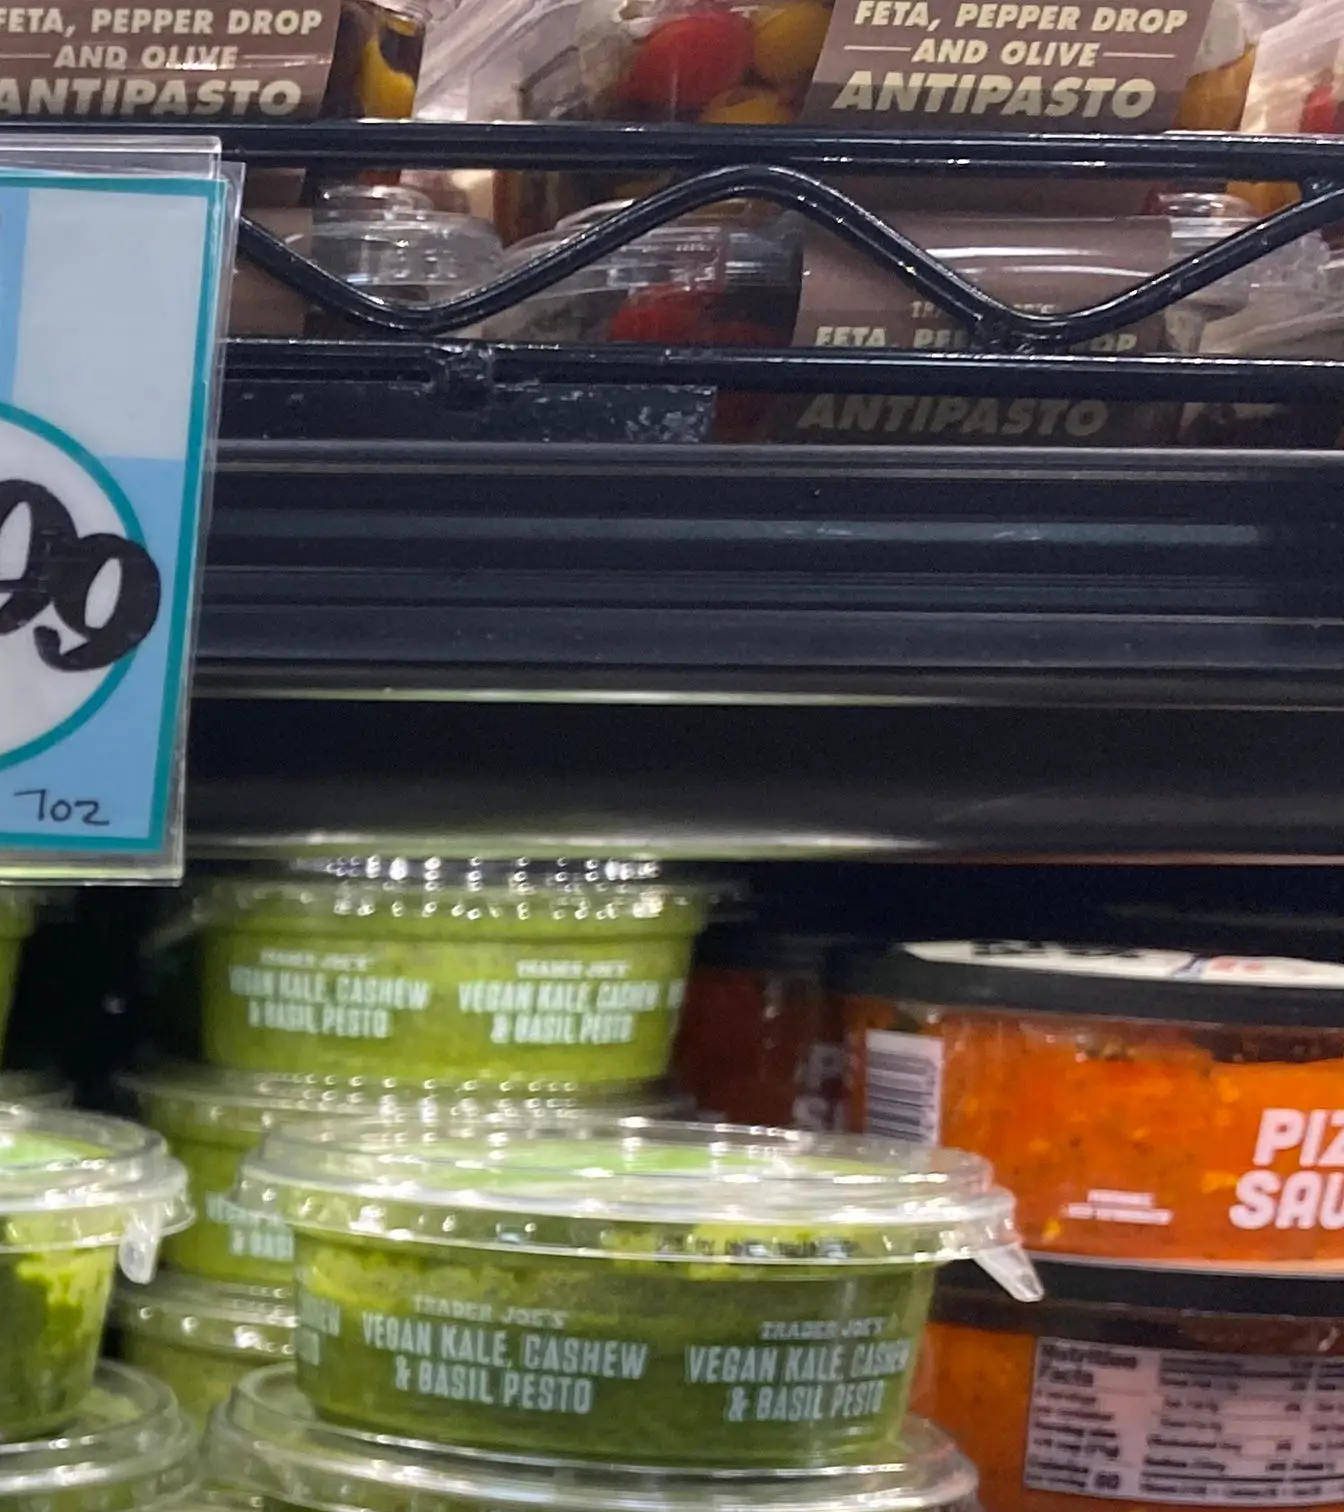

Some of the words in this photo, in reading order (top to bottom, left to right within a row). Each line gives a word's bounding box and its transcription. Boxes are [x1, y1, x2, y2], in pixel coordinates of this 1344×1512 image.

[91, 8, 214, 35] PEPPER
[227, 10, 322, 35] DROP
[854, 0, 941, 32] FETA,
[955, 3, 1080, 31] PEPPER
[1091, 8, 1188, 34] DROP
[53, 45, 128, 69] AND
[141, 45, 238, 71] OLIVE
[912, 38, 989, 64] AND
[1001, 41, 1100, 67] OLIVE
[831, 71, 1156, 119] ANTIPASTO
[796, 394, 1109, 437] ANTIPASTO
[362, 1312, 431, 1354] VEGAN
[523, 1334, 647, 1379] CASHEW
[419, 1362, 494, 1405] BASIL
[504, 1373, 593, 1415] PESTO
